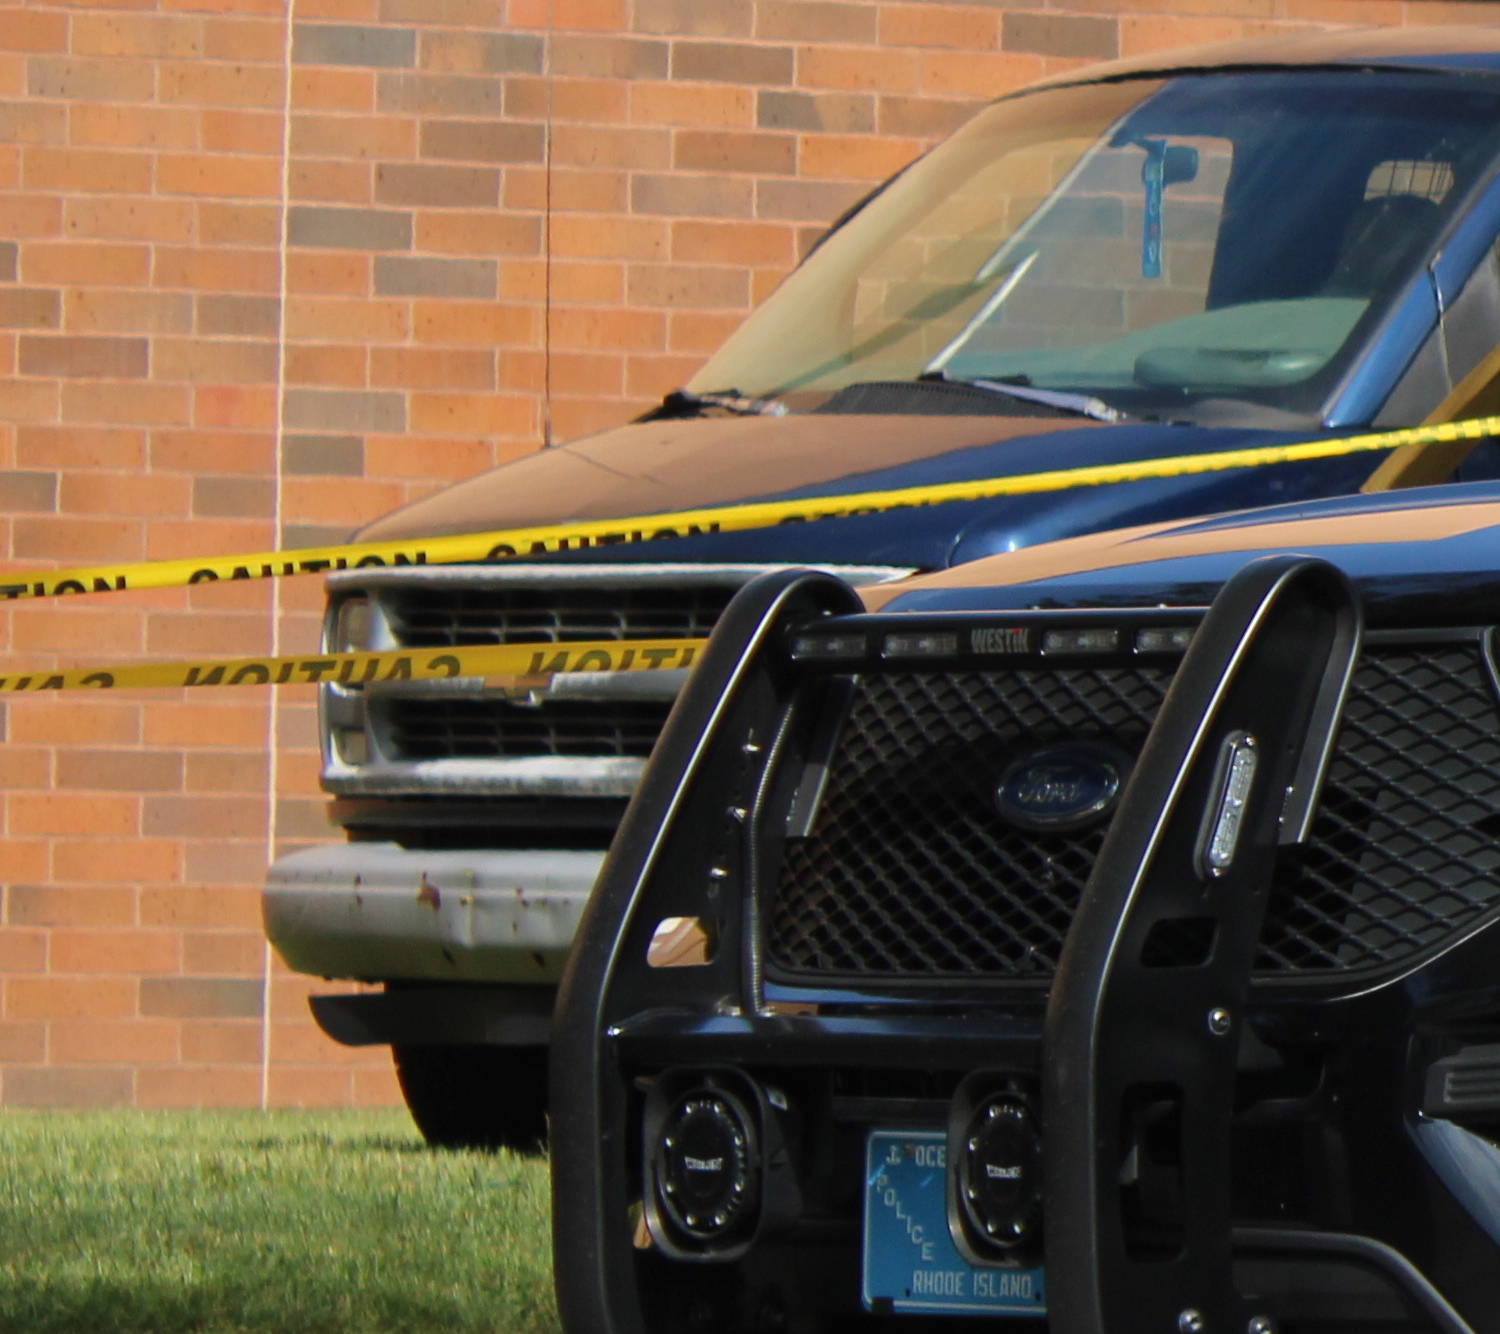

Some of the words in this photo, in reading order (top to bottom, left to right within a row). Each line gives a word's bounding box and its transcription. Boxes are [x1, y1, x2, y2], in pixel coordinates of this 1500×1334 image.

[876, 1172, 934, 1262] POLICE
[912, 1270, 966, 1297] RHODE
[972, 1272, 1033, 1299] ISLAND
